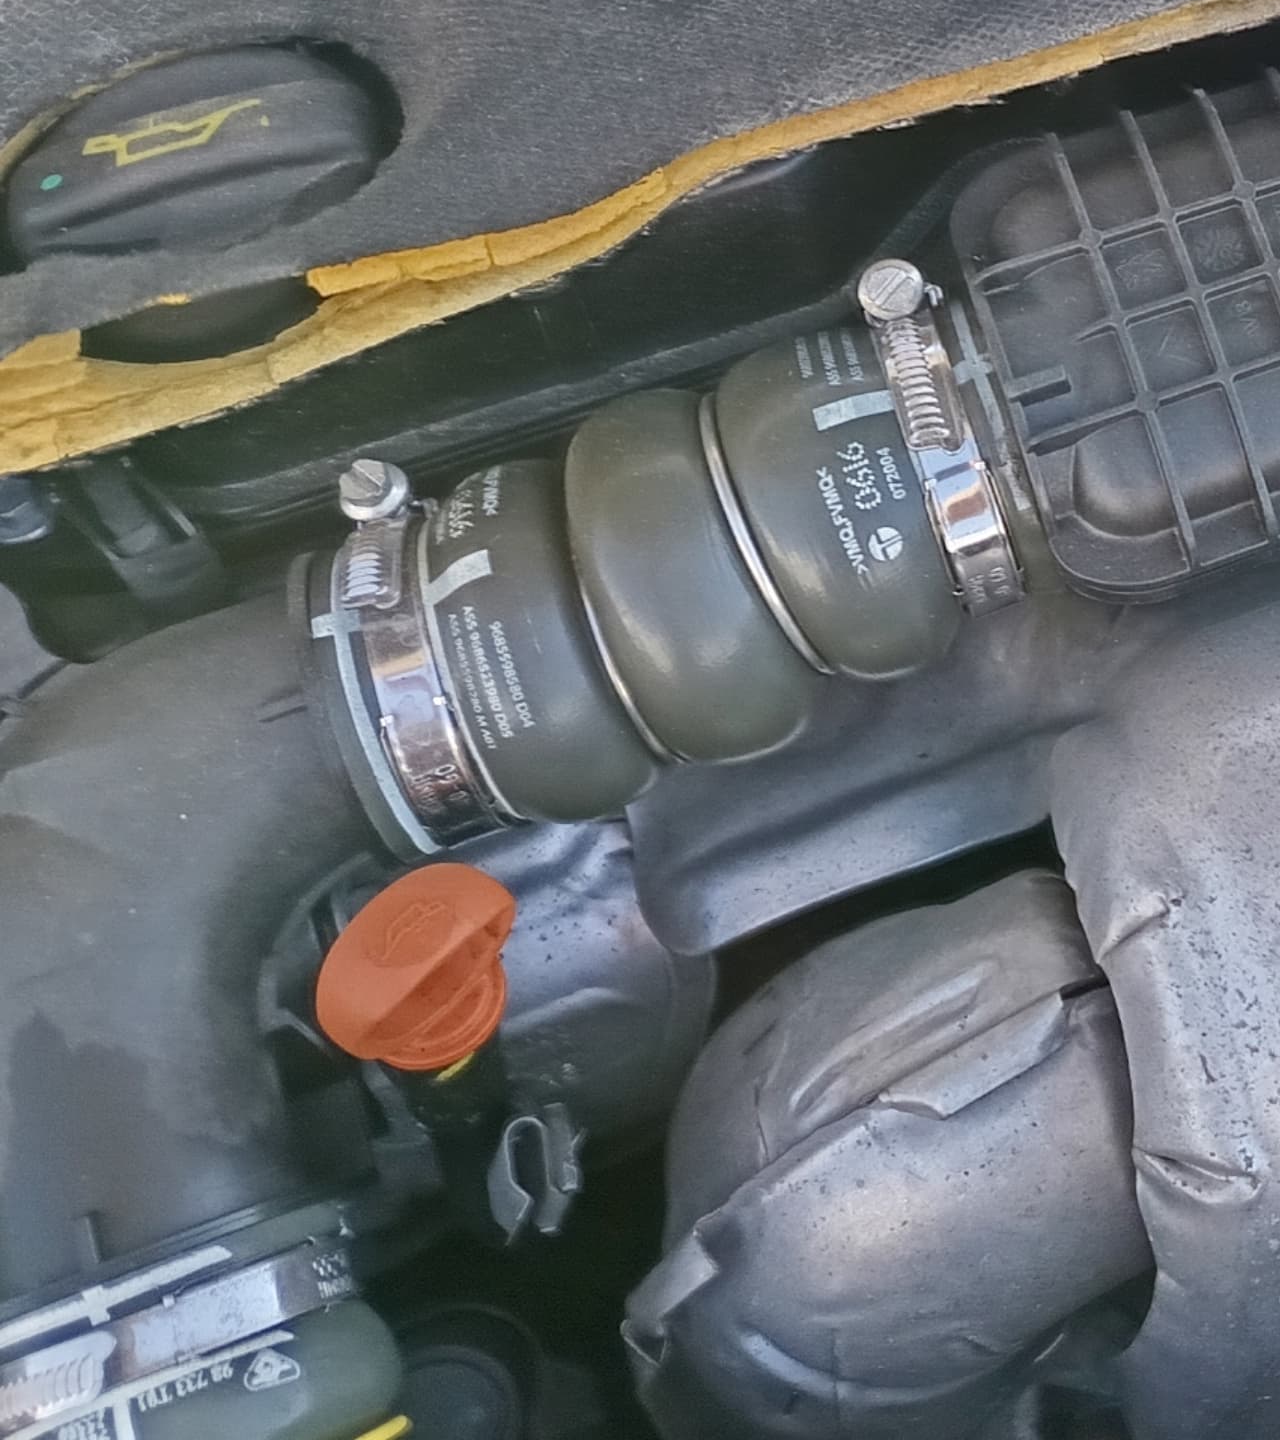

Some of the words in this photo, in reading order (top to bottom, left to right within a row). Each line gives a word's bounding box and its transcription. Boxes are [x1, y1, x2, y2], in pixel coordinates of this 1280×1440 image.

[877, 446, 906, 499] 072004
[447, 613, 459, 637] ASS
[461, 605, 477, 631] ASS
[513, 700, 536, 729] D04
